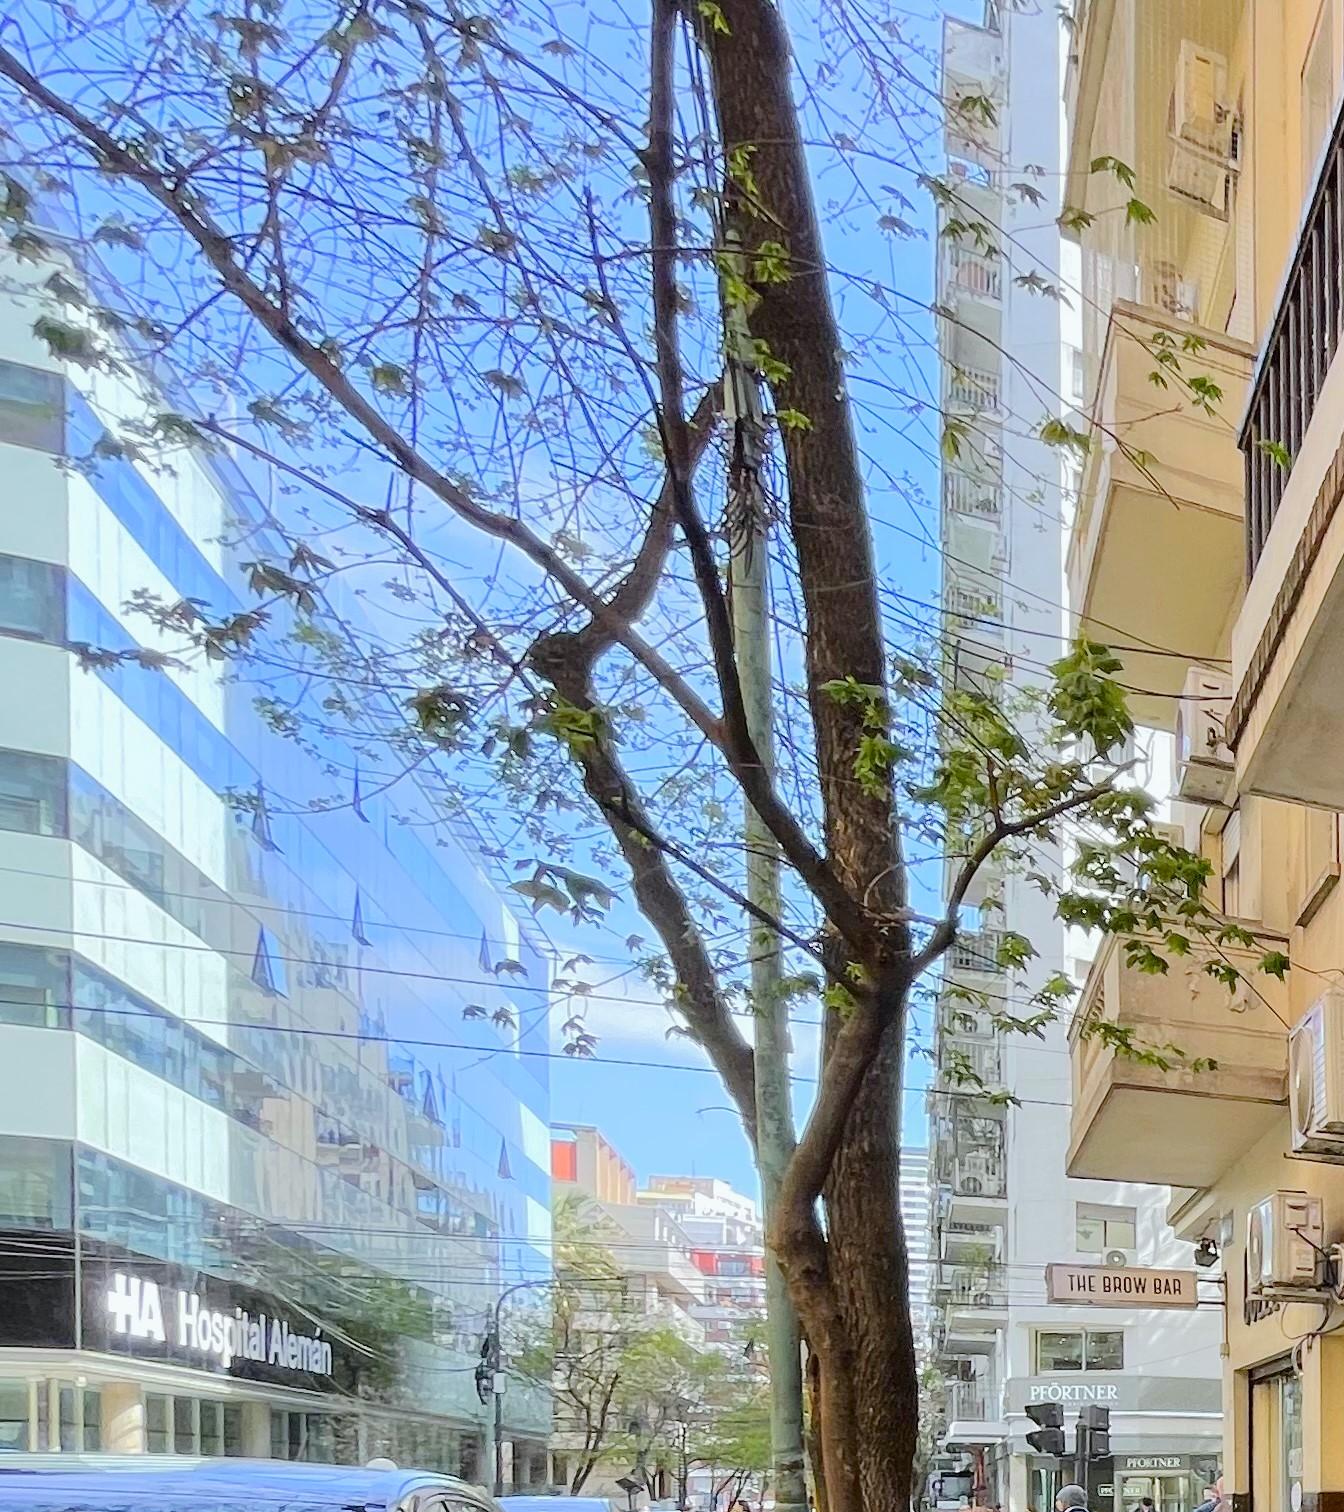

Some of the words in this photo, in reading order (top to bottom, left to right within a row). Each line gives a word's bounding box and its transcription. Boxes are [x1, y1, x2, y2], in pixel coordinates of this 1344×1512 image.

[1067, 1274, 1096, 1292] THE
[1103, 1276, 1147, 1294] BROW
[1153, 1278, 1182, 1295] BAR
[178, 1289, 266, 1368] Hospital
[268, 1318, 332, 1375] Alemán
[1030, 1382, 1118, 1400] PFÖRTNER
